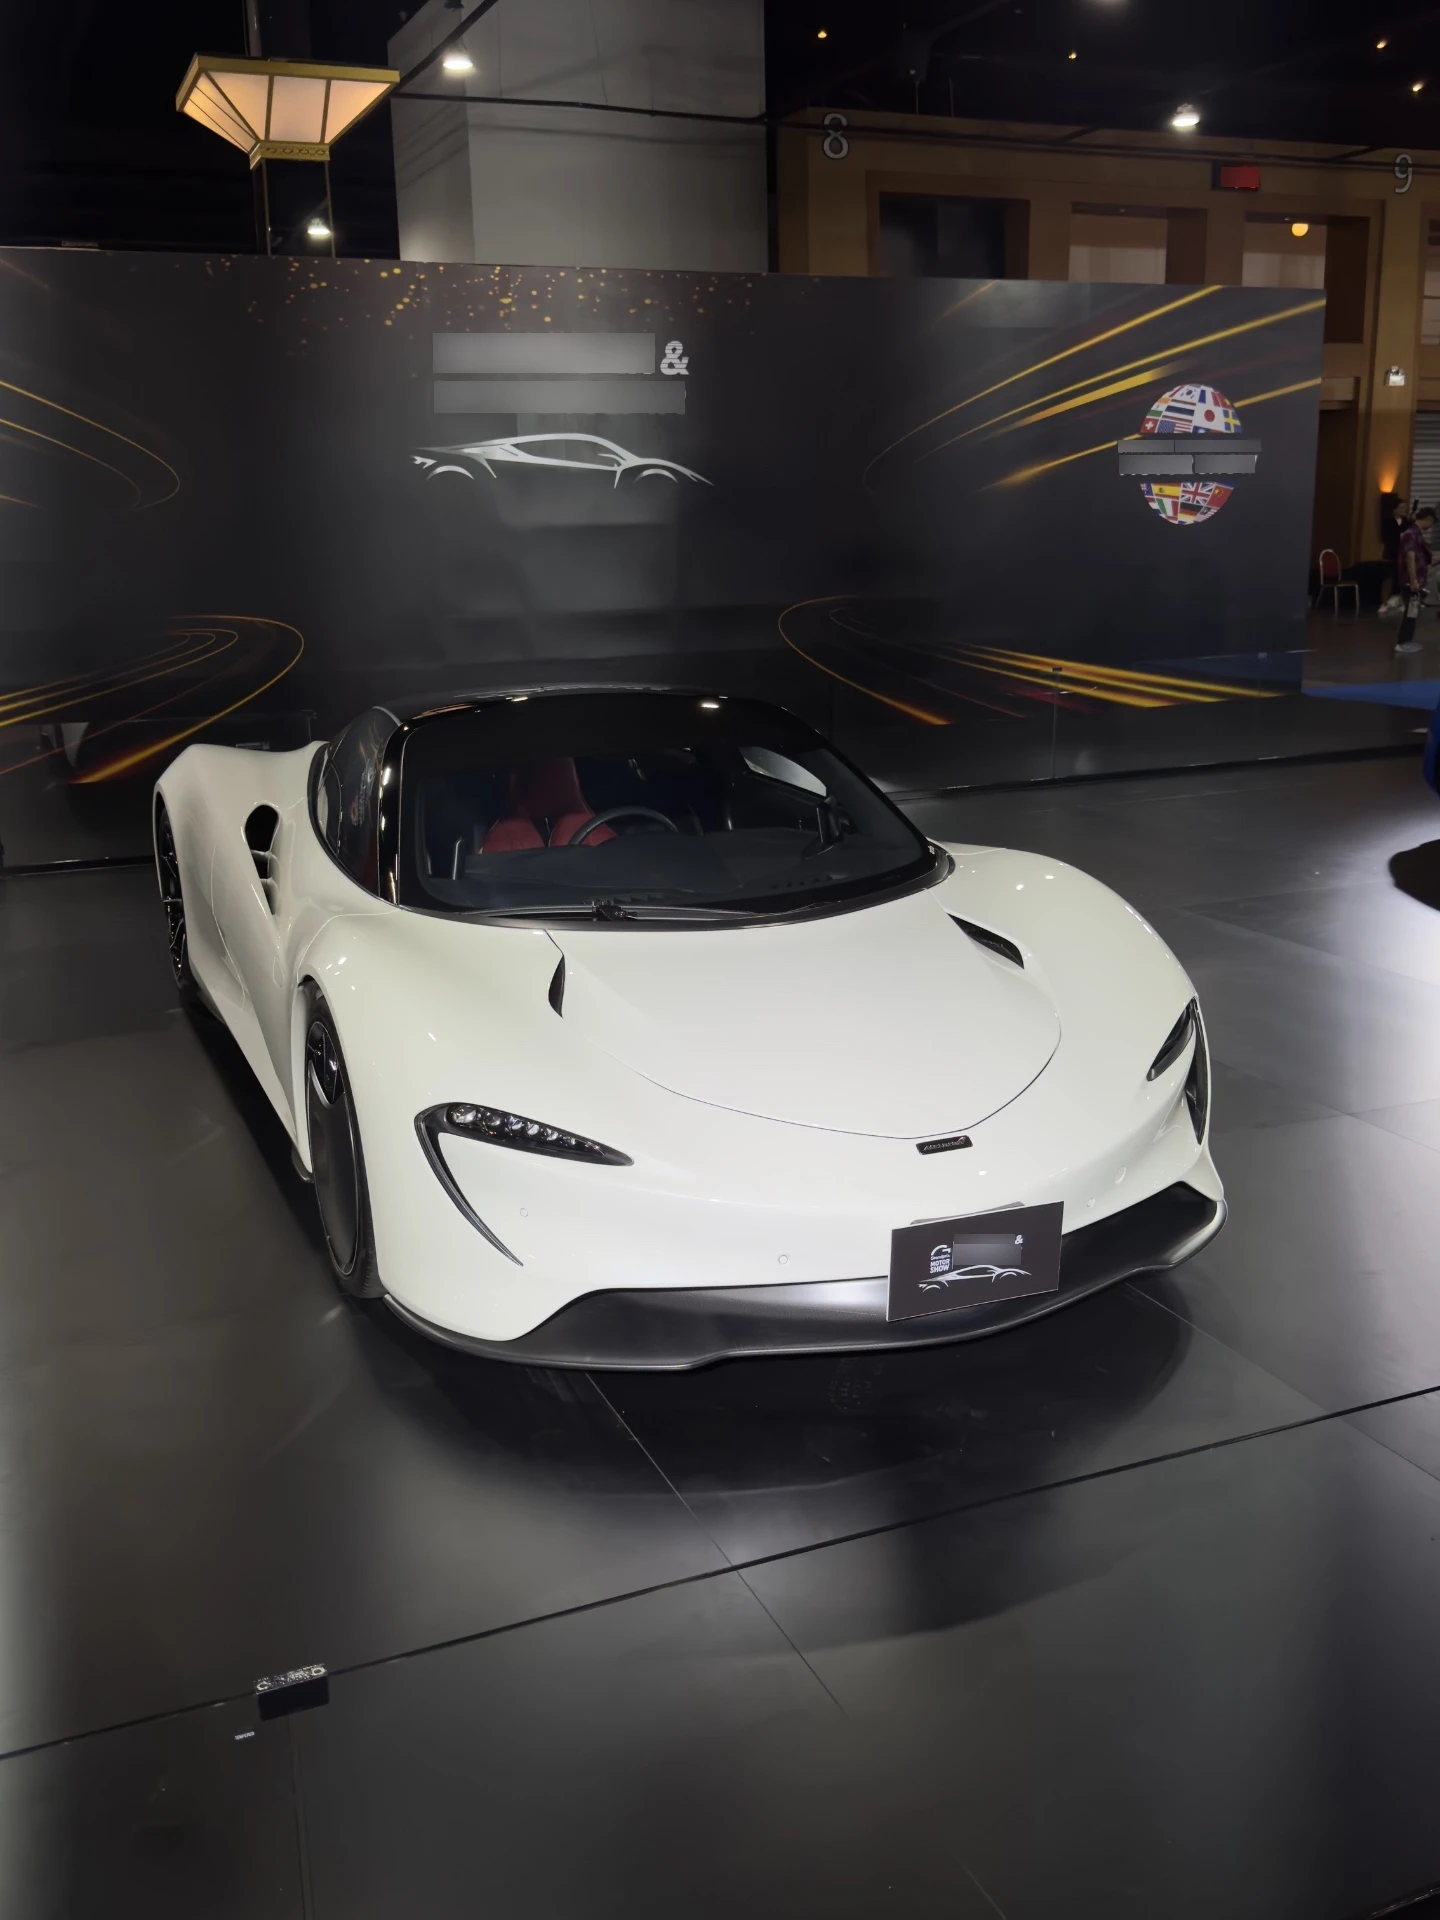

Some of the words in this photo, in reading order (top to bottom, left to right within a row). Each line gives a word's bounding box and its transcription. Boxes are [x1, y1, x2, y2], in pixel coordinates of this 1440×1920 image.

[823, 113, 849, 159] 8
[1394, 153, 1413, 193] 9
[659, 340, 690, 376] &
[929, 1265, 950, 1274] SHOW
[930, 1259, 950, 1268] MOTOR
